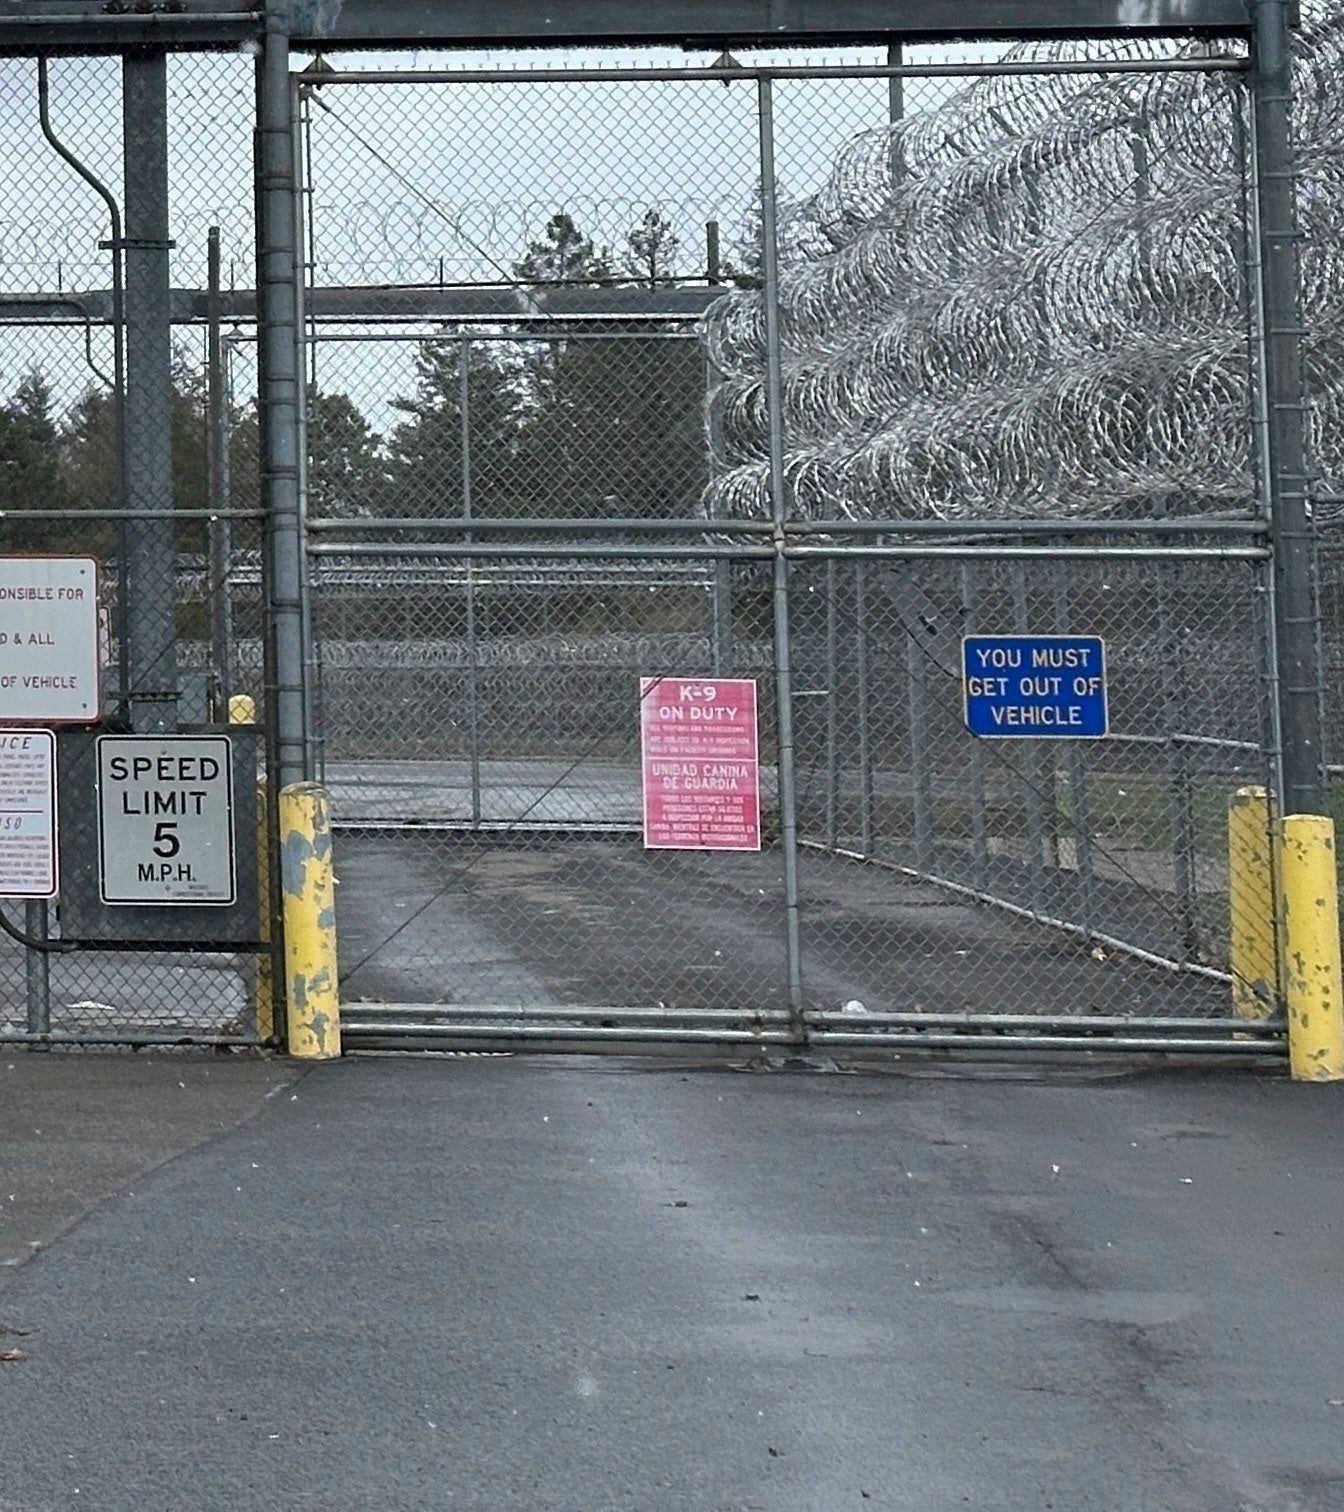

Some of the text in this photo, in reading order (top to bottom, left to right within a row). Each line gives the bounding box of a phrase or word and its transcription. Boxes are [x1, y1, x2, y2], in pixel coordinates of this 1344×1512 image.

[58, 587, 84, 600] FOR
[13, 632, 23, 645] &
[28, 632, 54, 645] ALL
[976, 648, 1091, 668] YOU MUST
[0, 675, 17, 688] OF
[23, 675, 77, 689] VEHICLE
[968, 676, 1101, 696] GET OUT OF
[679, 685, 716, 702] K-9
[659, 706, 738, 720] ON DUTY
[990, 705, 1082, 725] VEHICLE
[110, 756, 219, 781] SPEED
[652, 763, 748, 778] UNIDAD CANINA
[663, 776, 738, 790] DE GUARDIA
[123, 791, 207, 815] LIMIT
[153, 822, 180, 858] 5
[138, 863, 197, 882] M.P.H.
